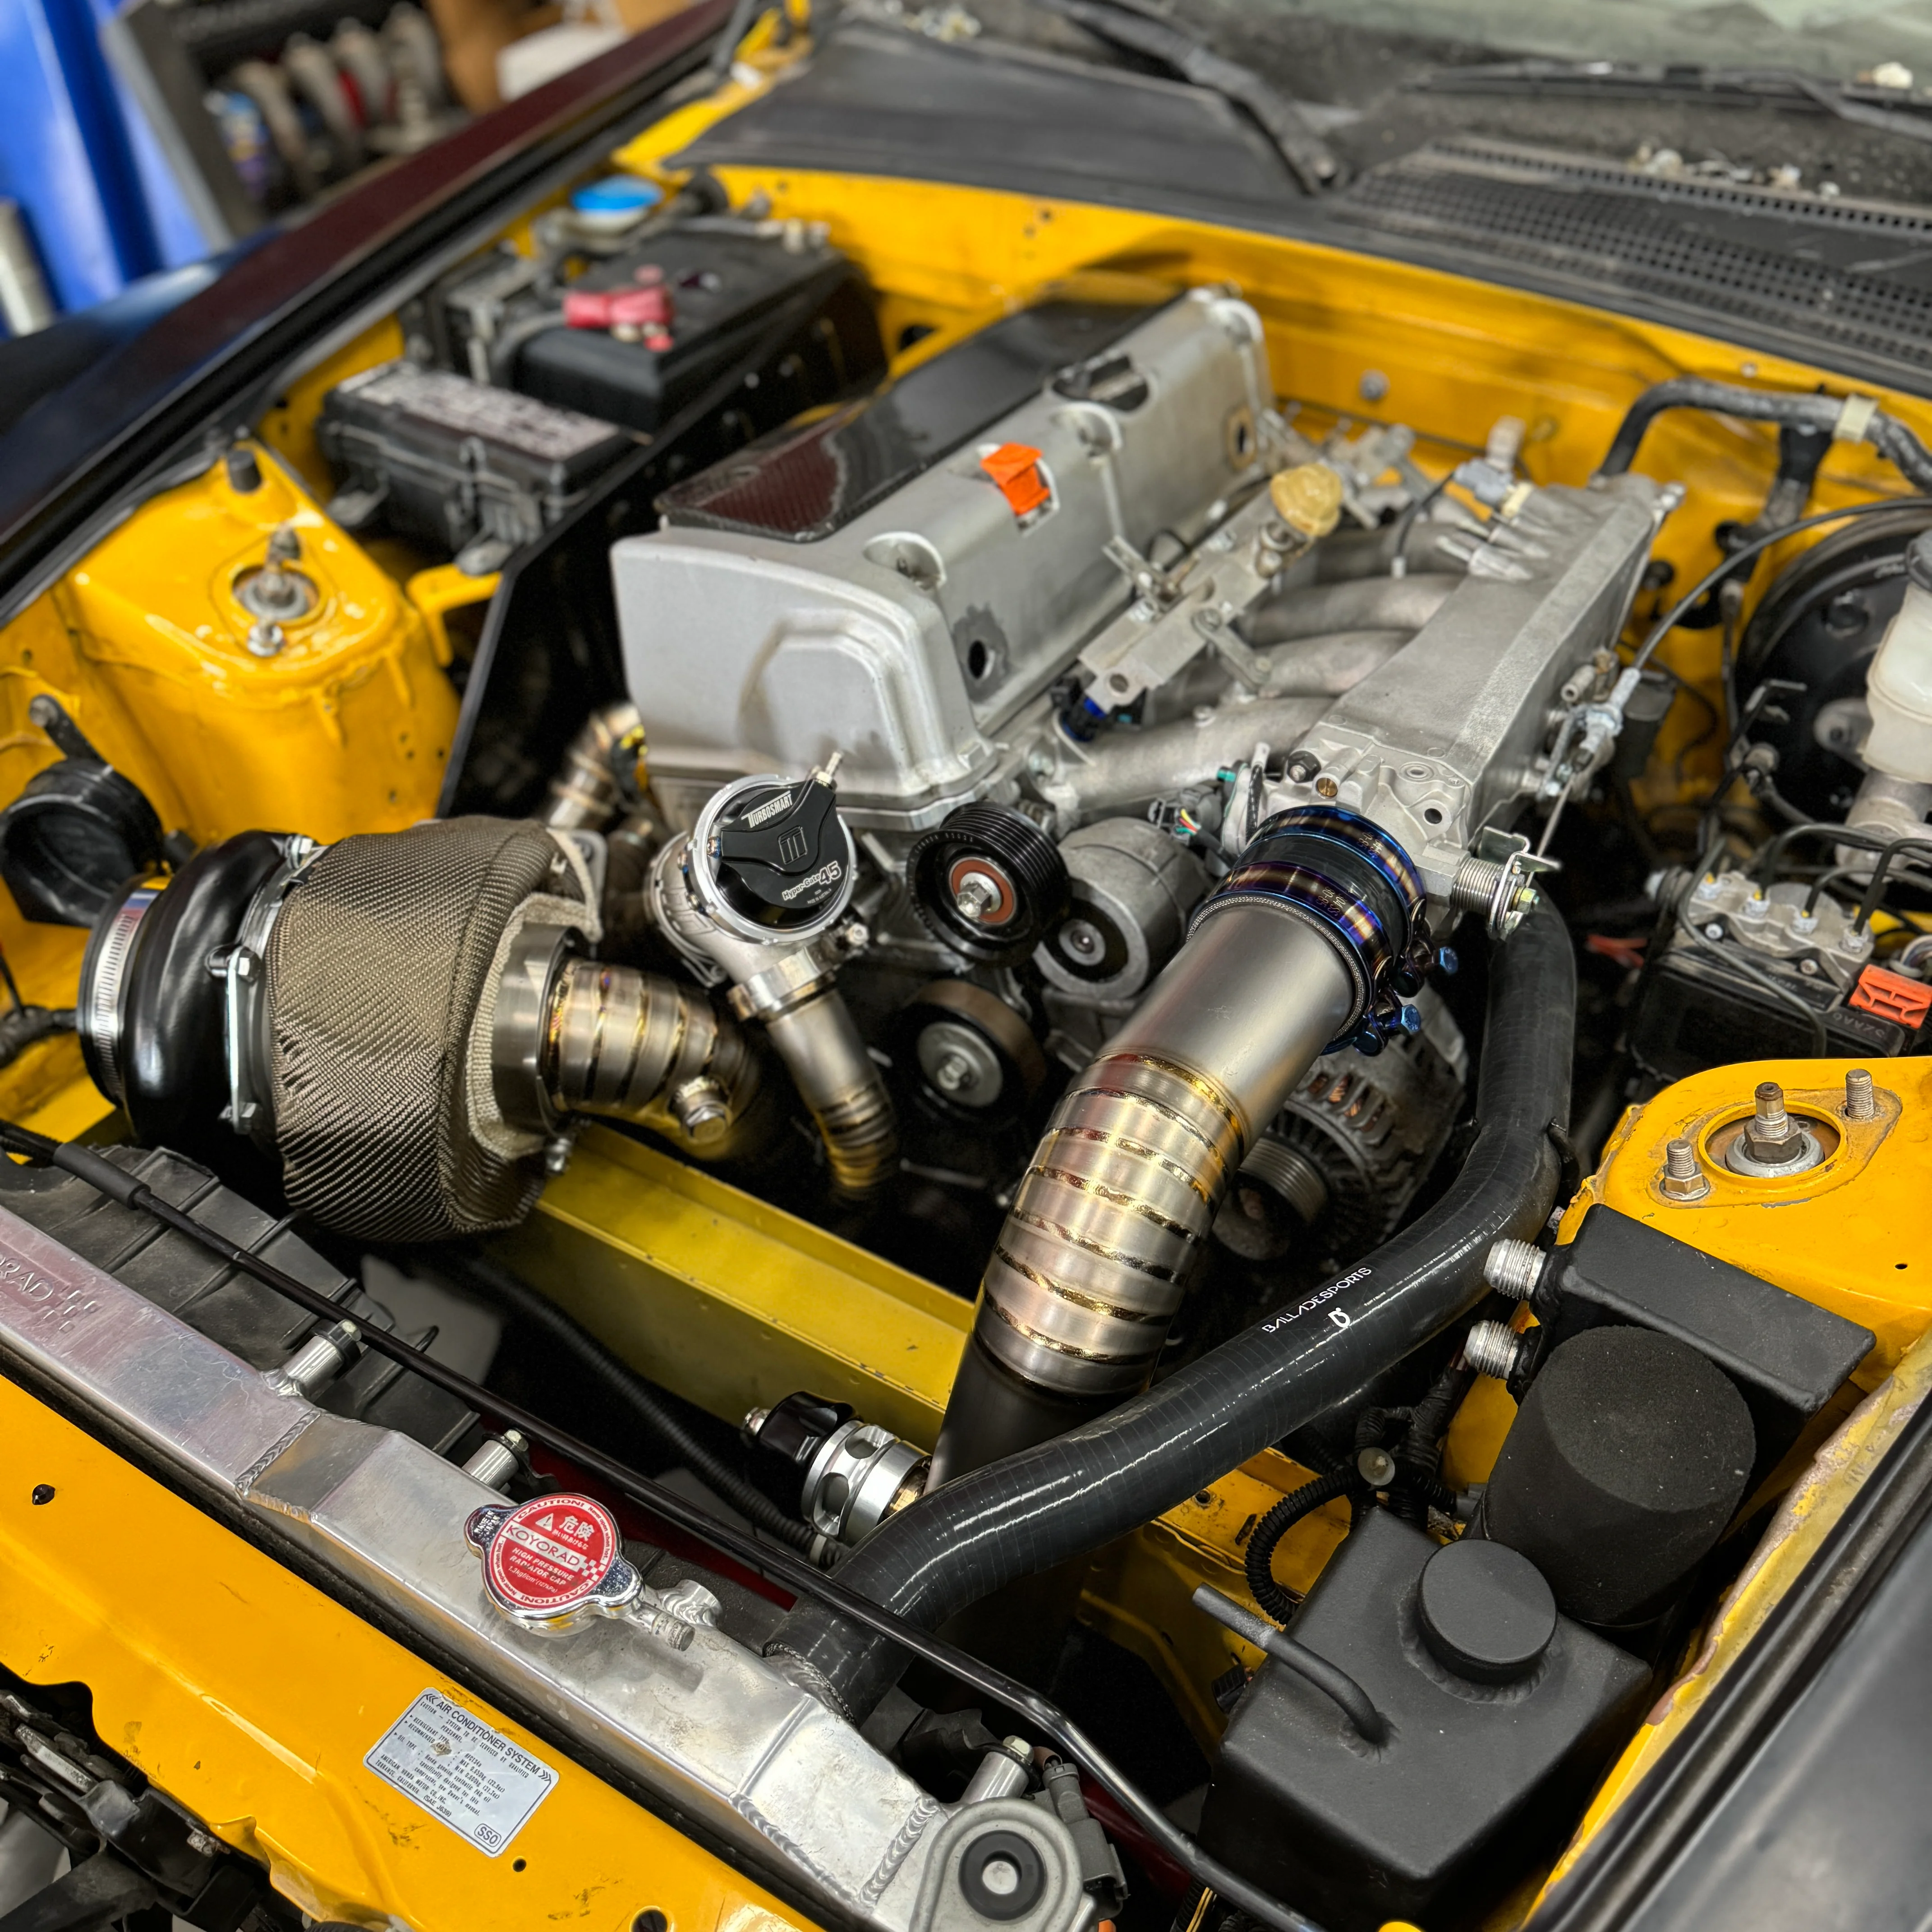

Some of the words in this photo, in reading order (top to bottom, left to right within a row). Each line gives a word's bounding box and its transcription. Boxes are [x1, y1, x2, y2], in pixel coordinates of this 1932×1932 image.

[741, 790, 792, 828] TURBOSMART
[1316, 887, 1335, 908] 80-85
[0, 1256, 54, 1302] RAD
[1262, 1267, 1372, 1333] BALLADESPORTS
[518, 1499, 585, 1519] CAUTION!
[588, 1506, 601, 1520] Never
[599, 1519, 608, 1532] open
[559, 1515, 595, 1541] 危険
[506, 1525, 580, 1566] KOYORAD
[510, 1555, 549, 1578] RADIATOR
[549, 1575, 567, 1586] CAP
[512, 1547, 534, 1561] HIGH
[533, 1557, 575, 1581] PRESSURE
[520, 1581, 589, 1604] CAUTION!
[420, 1701, 437, 1714] CAUTION
[436, 1701, 452, 1714] AIR
[451, 1711, 506, 1751] CONDITIONER
[505, 1747, 541, 1774] SYSTEM
[423, 1794, 437, 1806] (SAE
[436, 1805, 451, 1817] J639)
